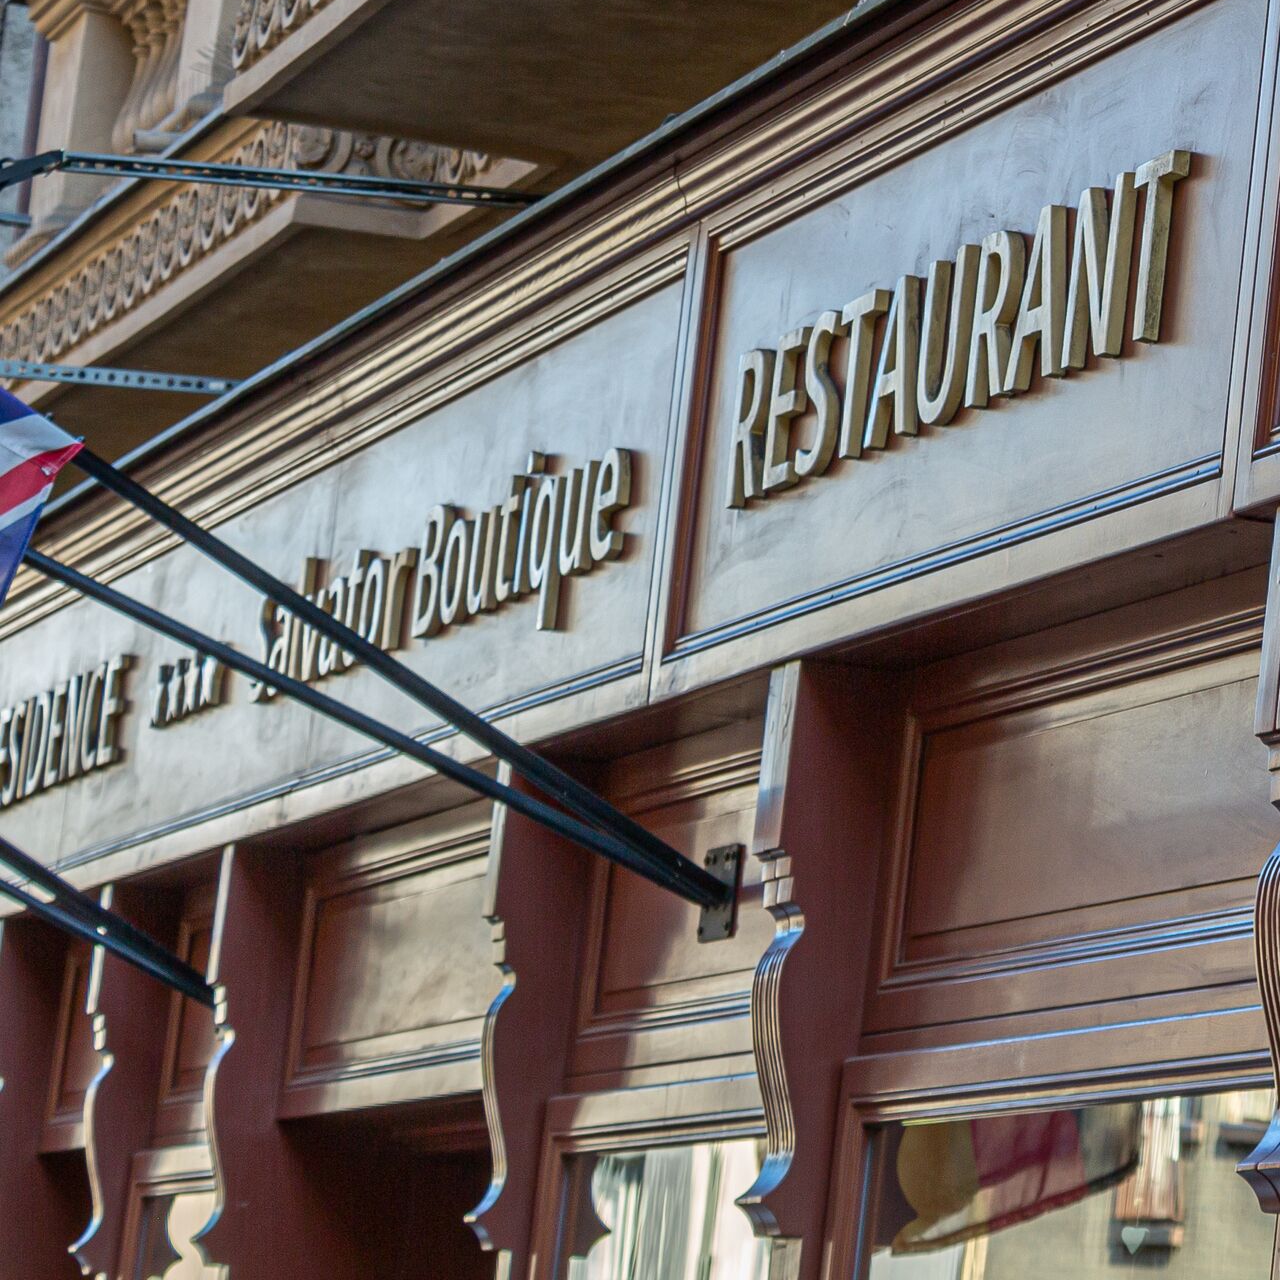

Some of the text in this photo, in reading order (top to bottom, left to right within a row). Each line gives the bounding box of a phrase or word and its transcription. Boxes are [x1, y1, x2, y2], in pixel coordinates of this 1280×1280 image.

[725, 149, 1191, 510] RESTAURANT
[248, 547, 421, 704] Salvator
[411, 447, 632, 639] Boutique
